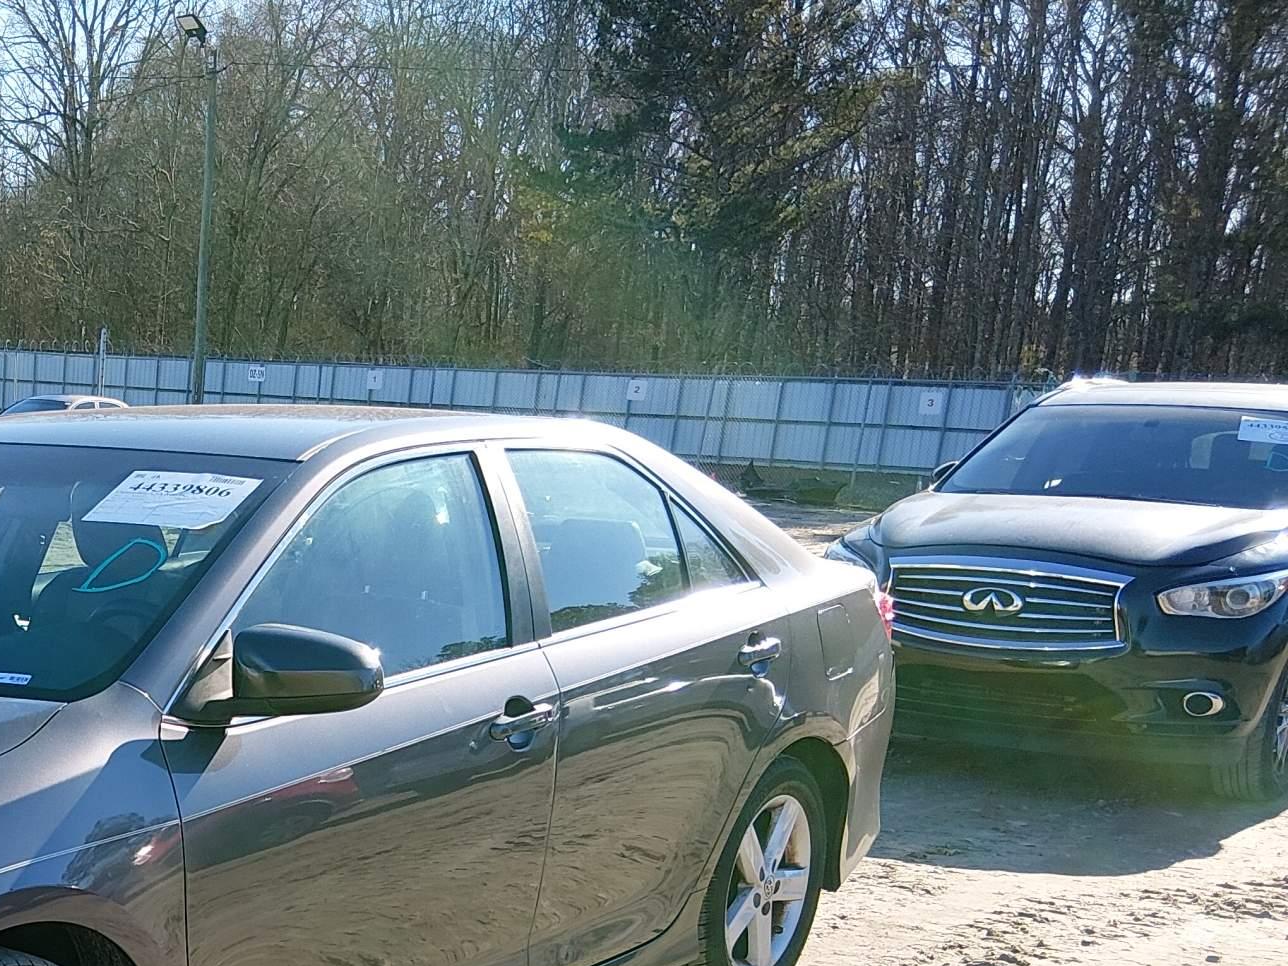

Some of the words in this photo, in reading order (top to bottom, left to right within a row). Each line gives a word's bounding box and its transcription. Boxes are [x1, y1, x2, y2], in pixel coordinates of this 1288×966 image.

[633, 385, 641, 394] 2
[927, 398, 935, 408] 3
[129, 481, 233, 498] 44339806
